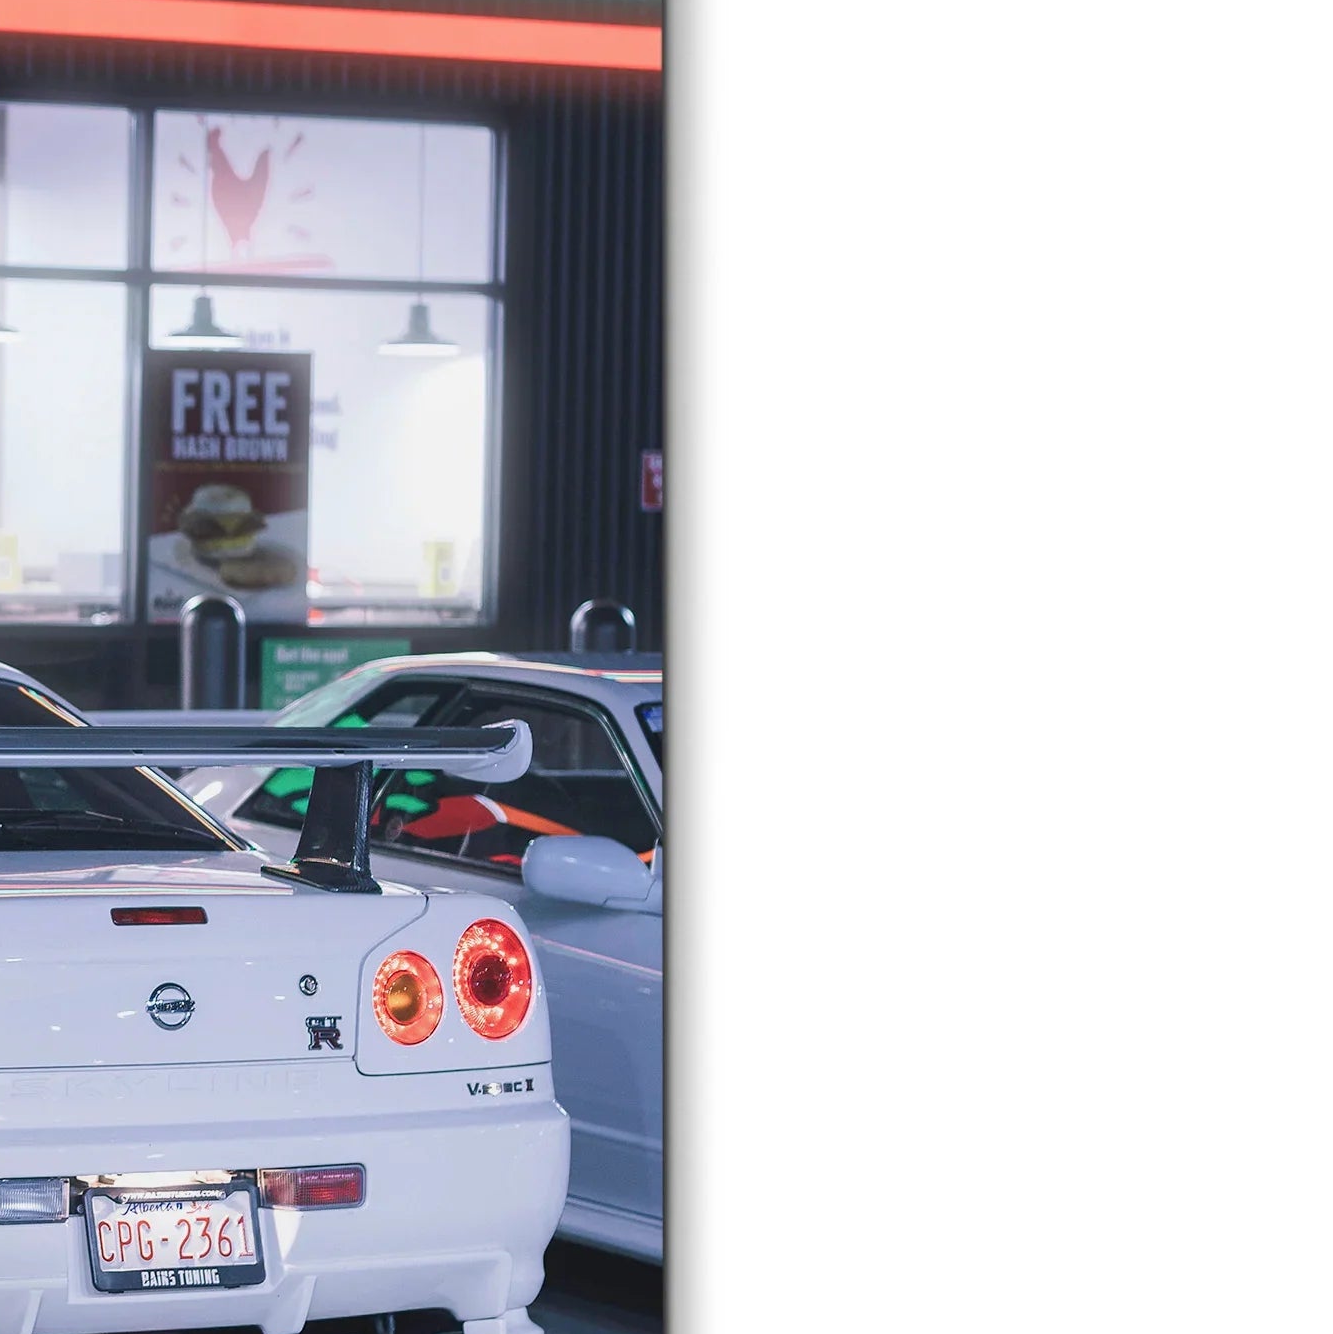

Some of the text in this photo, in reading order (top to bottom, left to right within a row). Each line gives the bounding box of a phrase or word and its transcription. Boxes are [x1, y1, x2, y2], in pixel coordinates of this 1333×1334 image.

[171, 368, 291, 437] FREE
[224, 436, 288, 462] BROWN
[121, 1202, 174, 1216] Alberta
[97, 1214, 254, 1263] CPG-2361
[177, 1268, 220, 1286] TUNING
